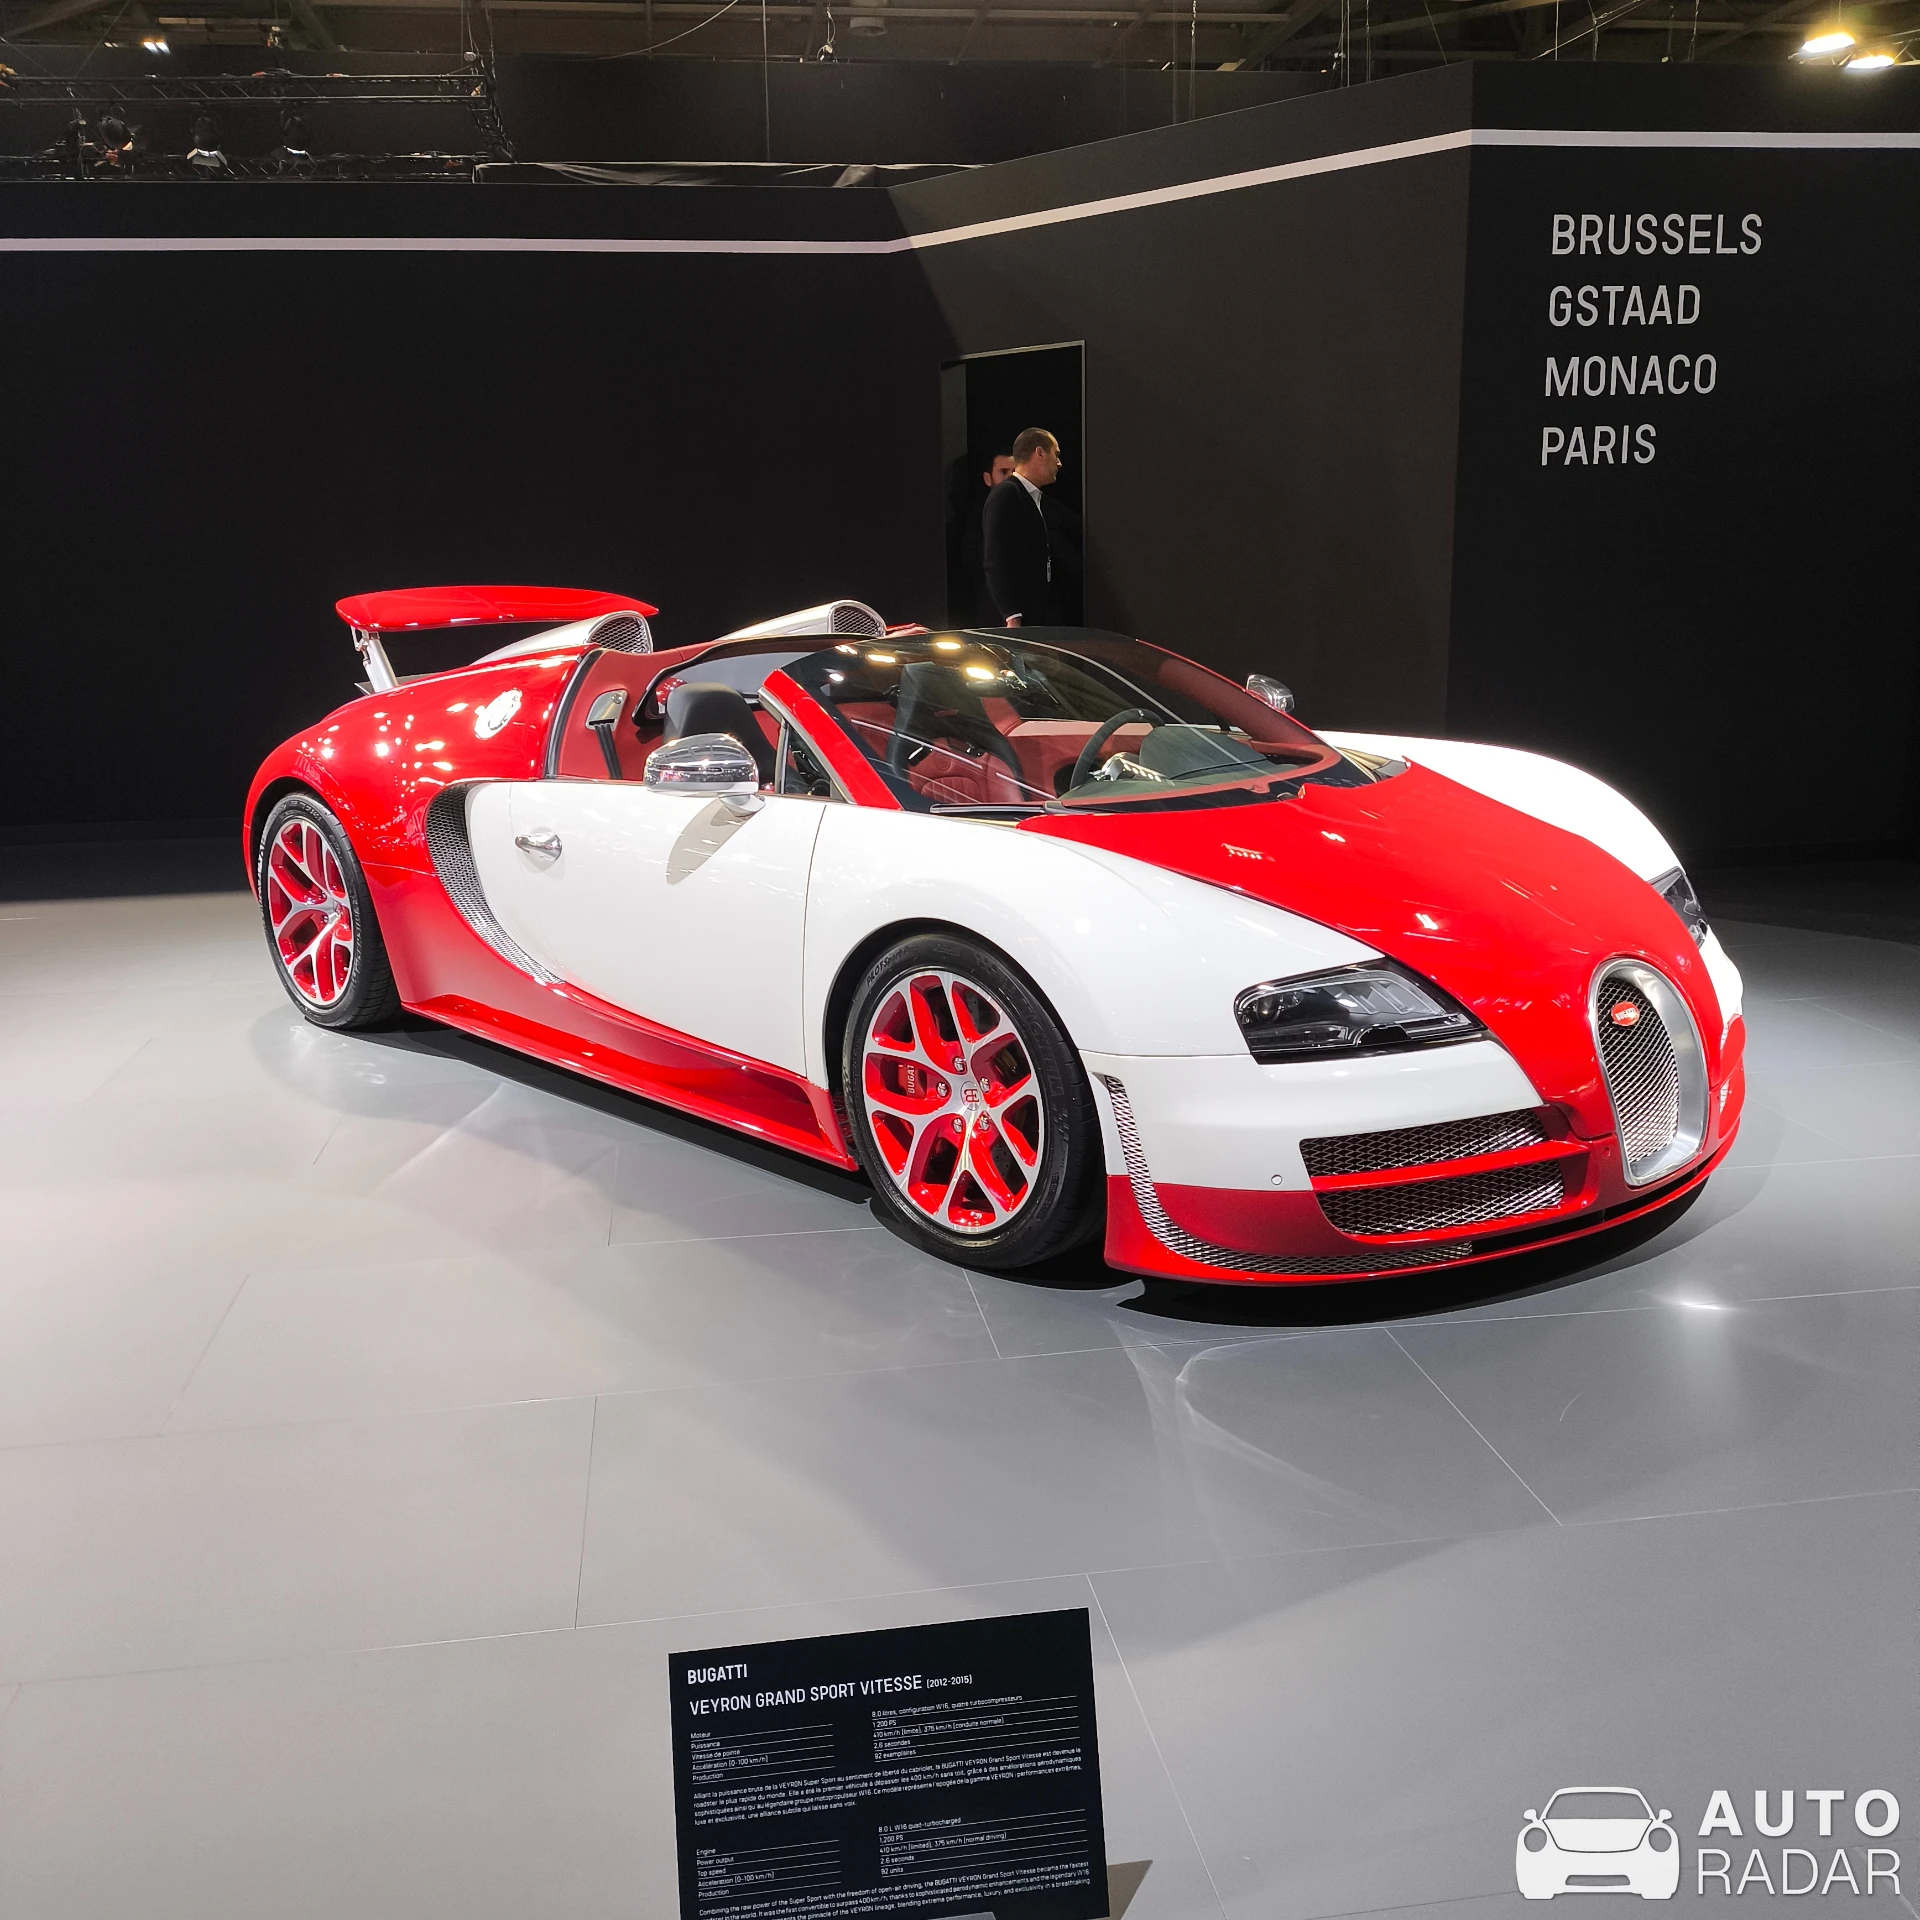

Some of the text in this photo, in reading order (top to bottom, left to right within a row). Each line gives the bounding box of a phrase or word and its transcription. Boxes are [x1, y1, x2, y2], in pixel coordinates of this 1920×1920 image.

[1552, 213, 1763, 255] BRUSSELS
[1549, 284, 1701, 327] GSTAAD
[1545, 353, 1717, 396] MONACO
[1541, 423, 1657, 466] PARIS
[907, 1064, 915, 1094] BUGAT
[687, 1663, 747, 1684] BUGATTI
[689, 1694, 751, 1715] VEYRON
[754, 1687, 805, 1707] GRAND
[809, 1682, 855, 1701] SPORT
[859, 1674, 922, 1695] VITESSE
[898, 1704, 935, 1716] configuration
[936, 1702, 950, 1711] W16,
[951, 1701, 968, 1710] quatre
[690, 1730, 710, 1739] Moteur
[690, 1740, 720, 1749] Puissance
[691, 1752, 712, 1760] Vitesse
[722, 1749, 740, 1757] pointe
[692, 1772, 723, 1781] Production
[908, 1817, 961, 1830] quad-turbocharged
[696, 1847, 715, 1856] Engine
[696, 1856, 734, 1866] Power output
[891, 1855, 914, 1863] seconds
[697, 1867, 726, 1877] Top speed
[697, 1877, 733, 1887] Acceleration
[698, 1888, 729, 1897] Production
